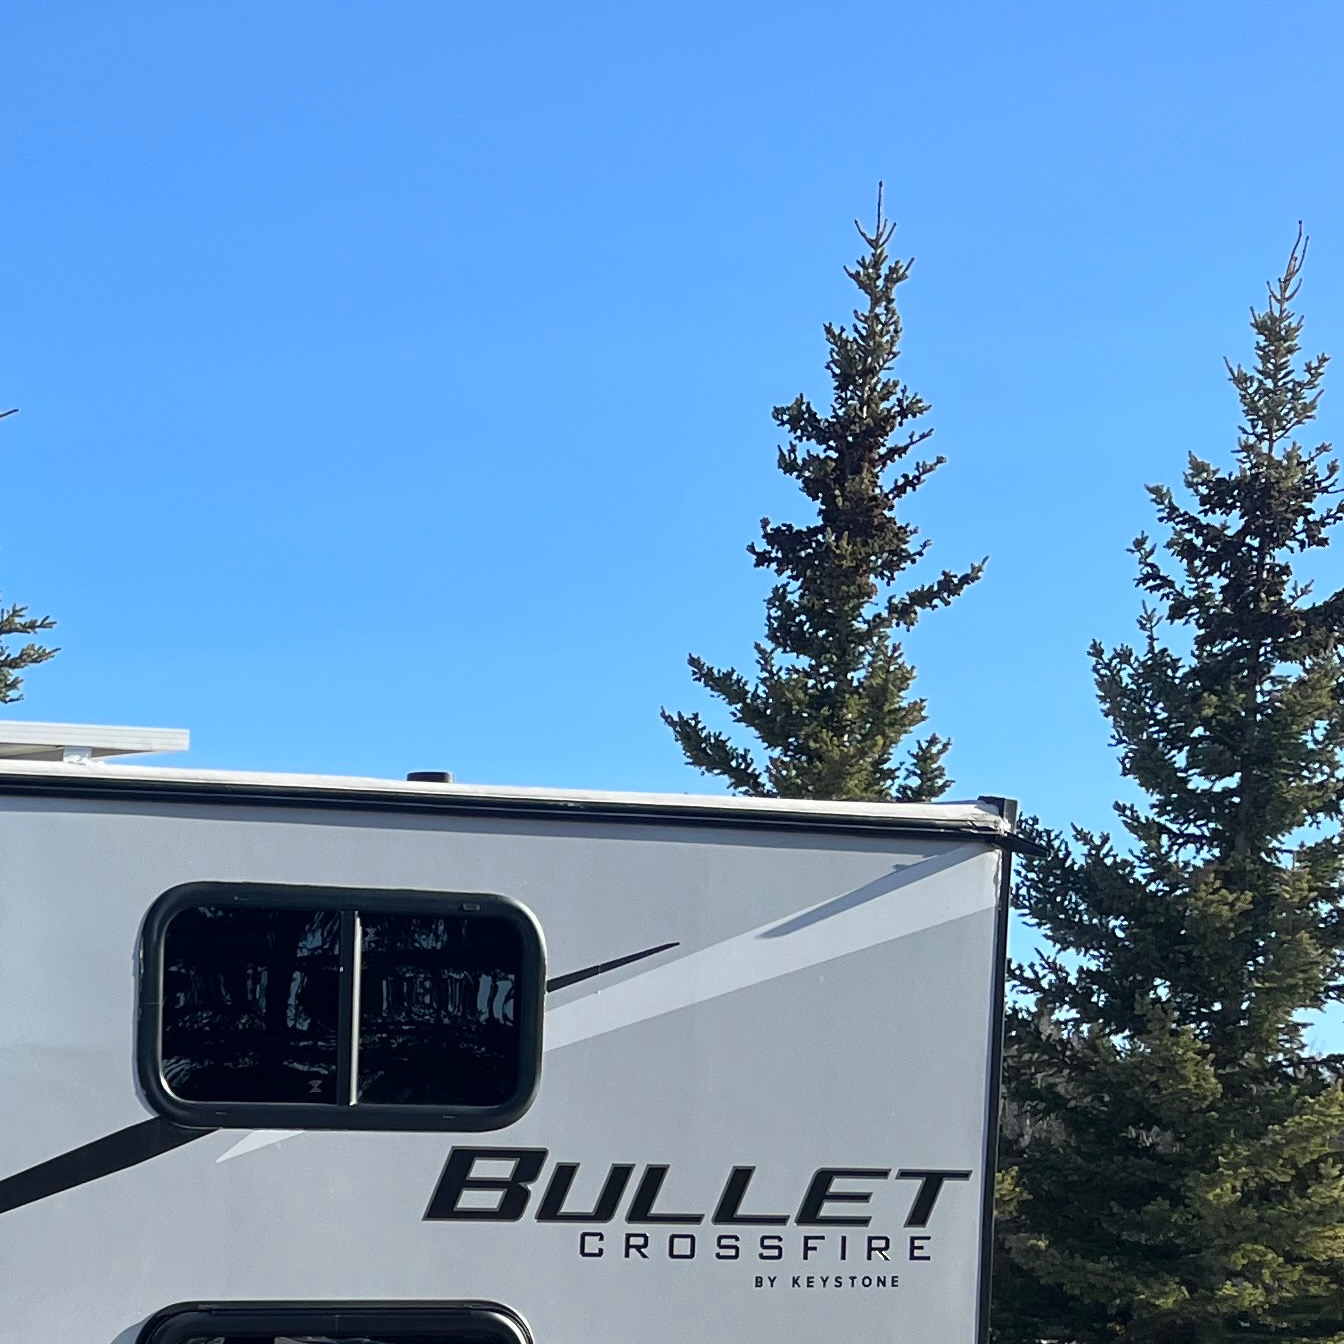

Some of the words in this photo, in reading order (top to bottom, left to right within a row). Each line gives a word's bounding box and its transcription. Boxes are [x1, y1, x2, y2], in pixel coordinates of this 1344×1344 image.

[421, 1145, 974, 1228] BULLET
[578, 1231, 933, 1262] CROSSFIRE
[754, 1275, 778, 1289] BY
[791, 1275, 901, 1289] KEYSTONE
